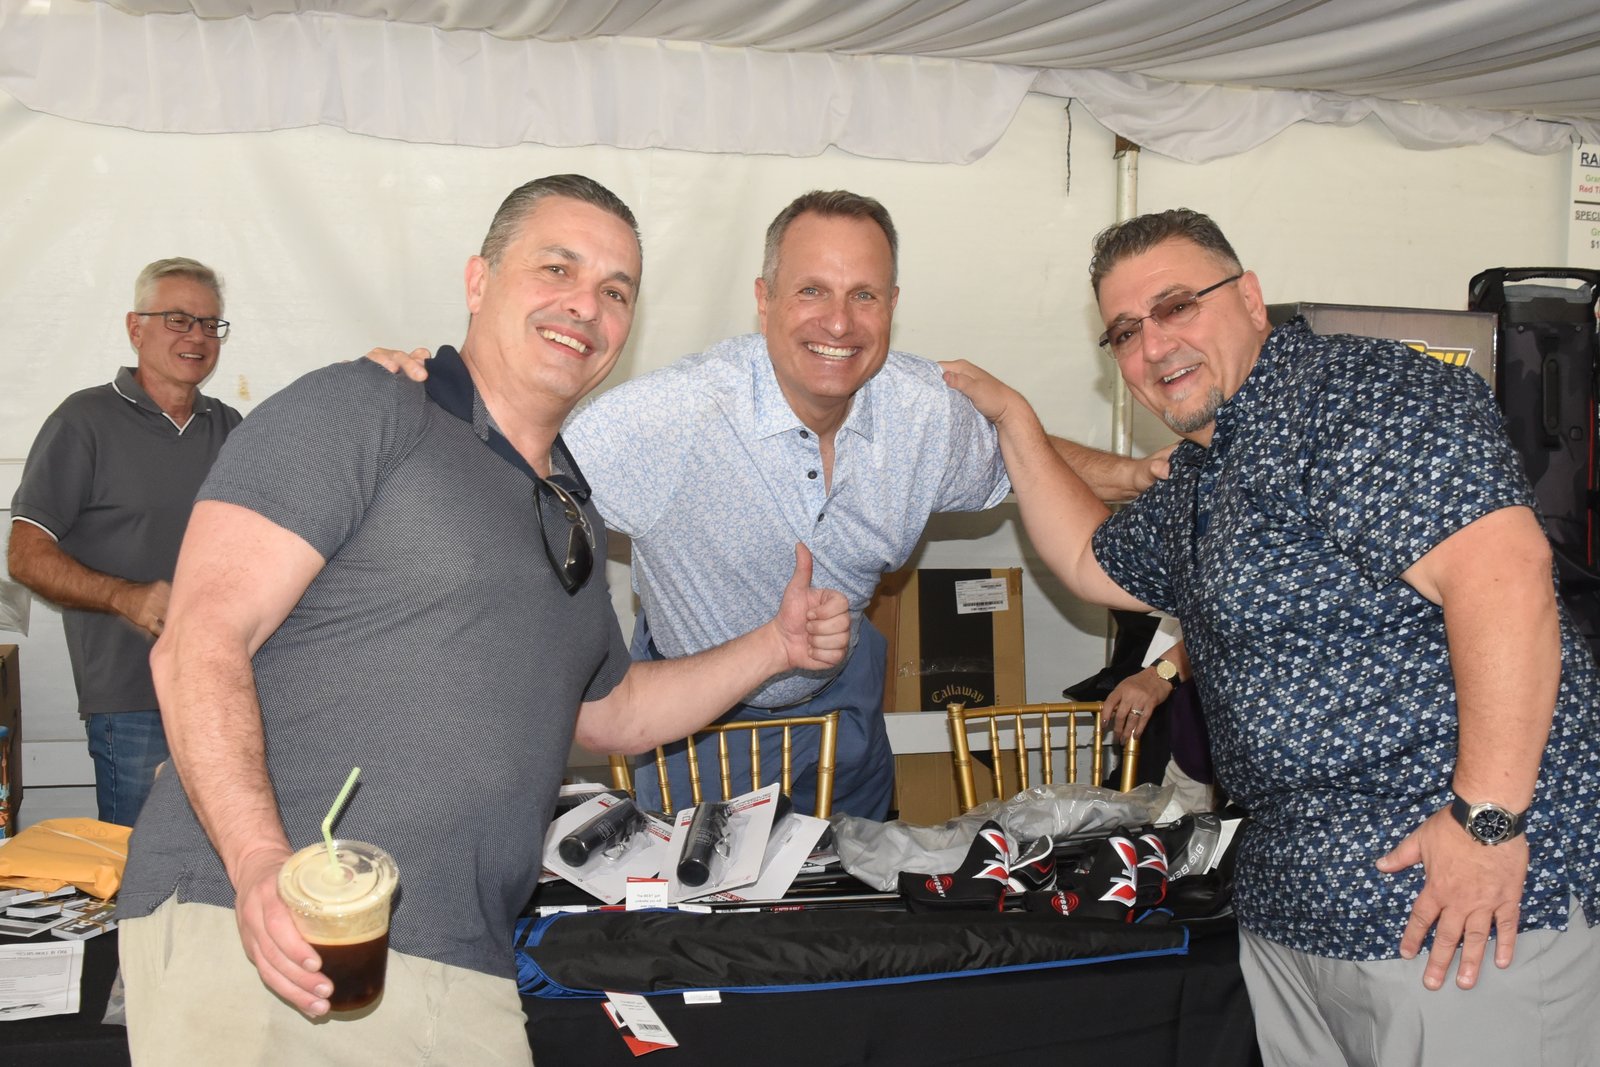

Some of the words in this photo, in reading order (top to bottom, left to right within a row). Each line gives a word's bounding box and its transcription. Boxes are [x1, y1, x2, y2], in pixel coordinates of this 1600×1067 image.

[1580, 152, 1600, 166] RA
[1579, 184, 1593, 193] Red
[931, 684, 984, 703] Callaway
[1189, 843, 1205, 866] BIG
[931, 874, 946, 898] DYSSEY
